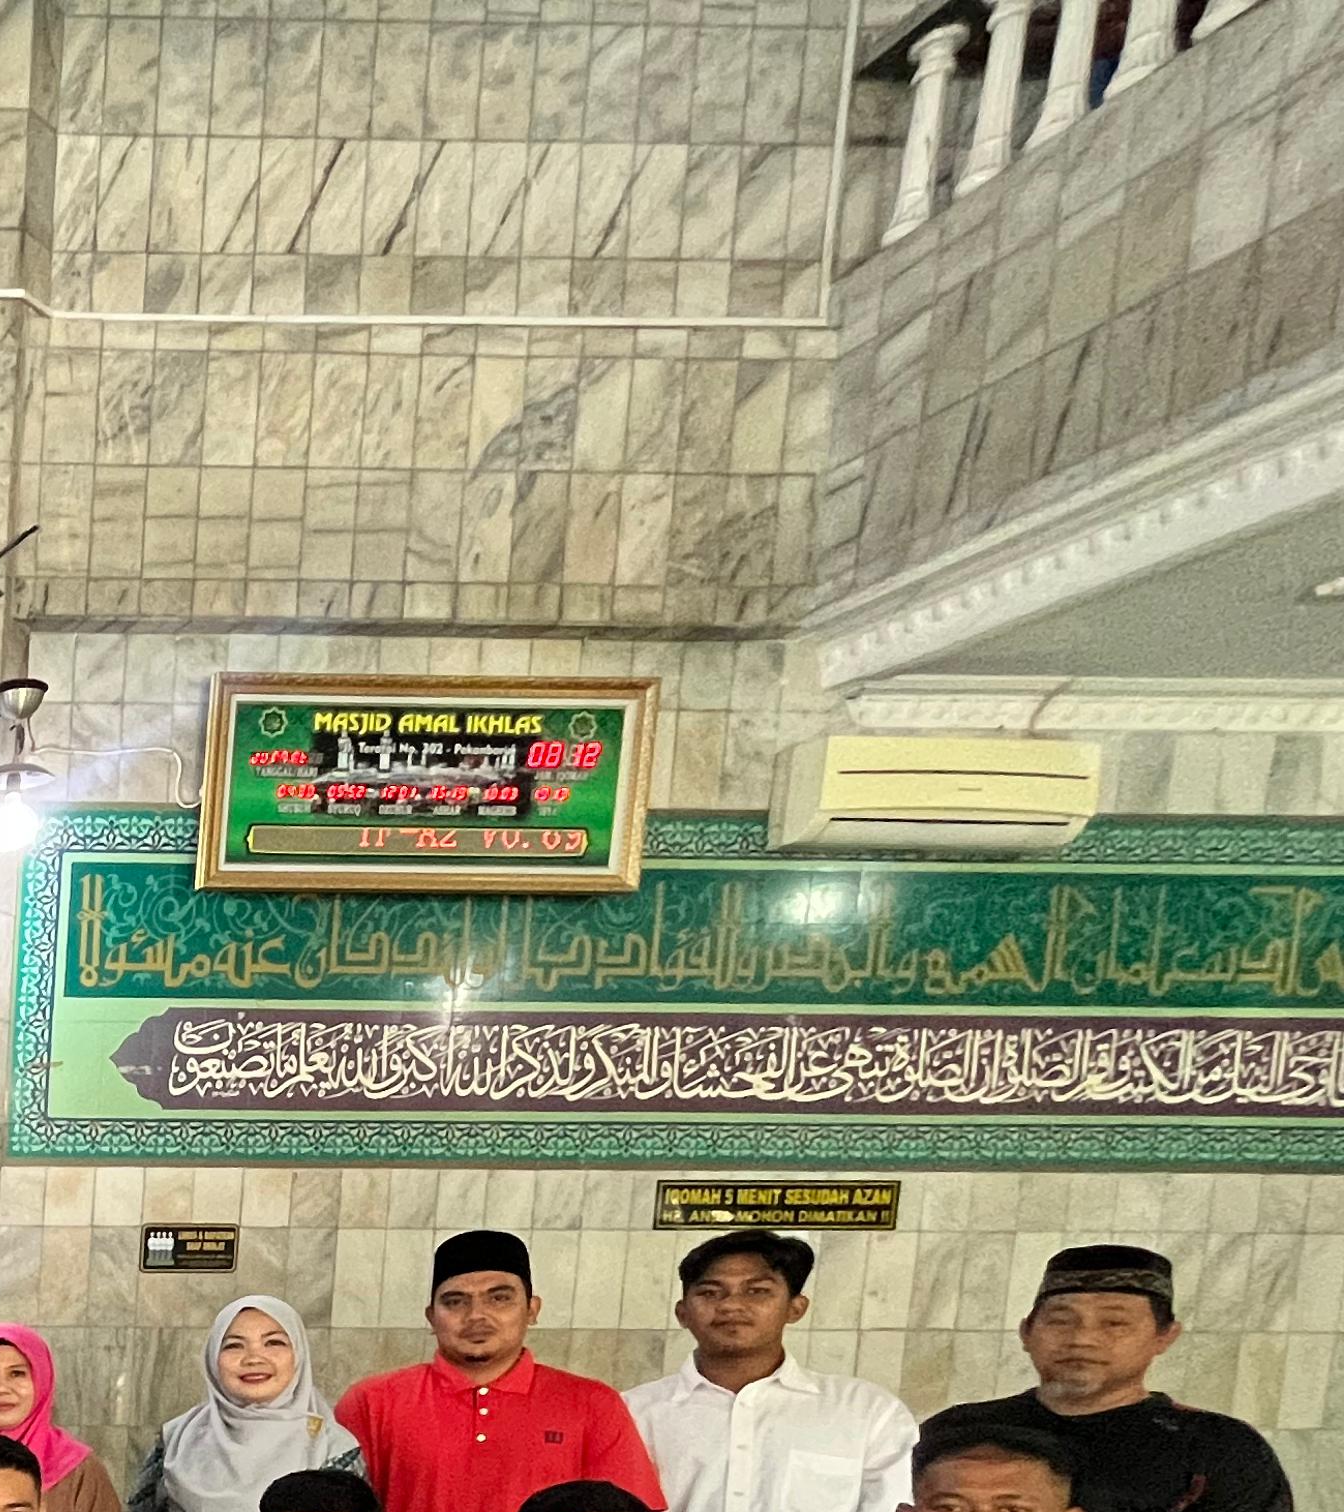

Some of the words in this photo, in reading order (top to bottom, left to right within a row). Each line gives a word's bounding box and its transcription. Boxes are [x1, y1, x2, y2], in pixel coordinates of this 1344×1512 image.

[314, 712, 392, 735] MASJID
[398, 714, 460, 734] AMAL
[466, 714, 544, 735] IKHLAS
[736, 1188, 782, 1205] MENIT
[784, 1188, 849, 1205] SESUDAH
[852, 1188, 892, 1205] AZAN
[734, 1210, 794, 1223] MOHON
